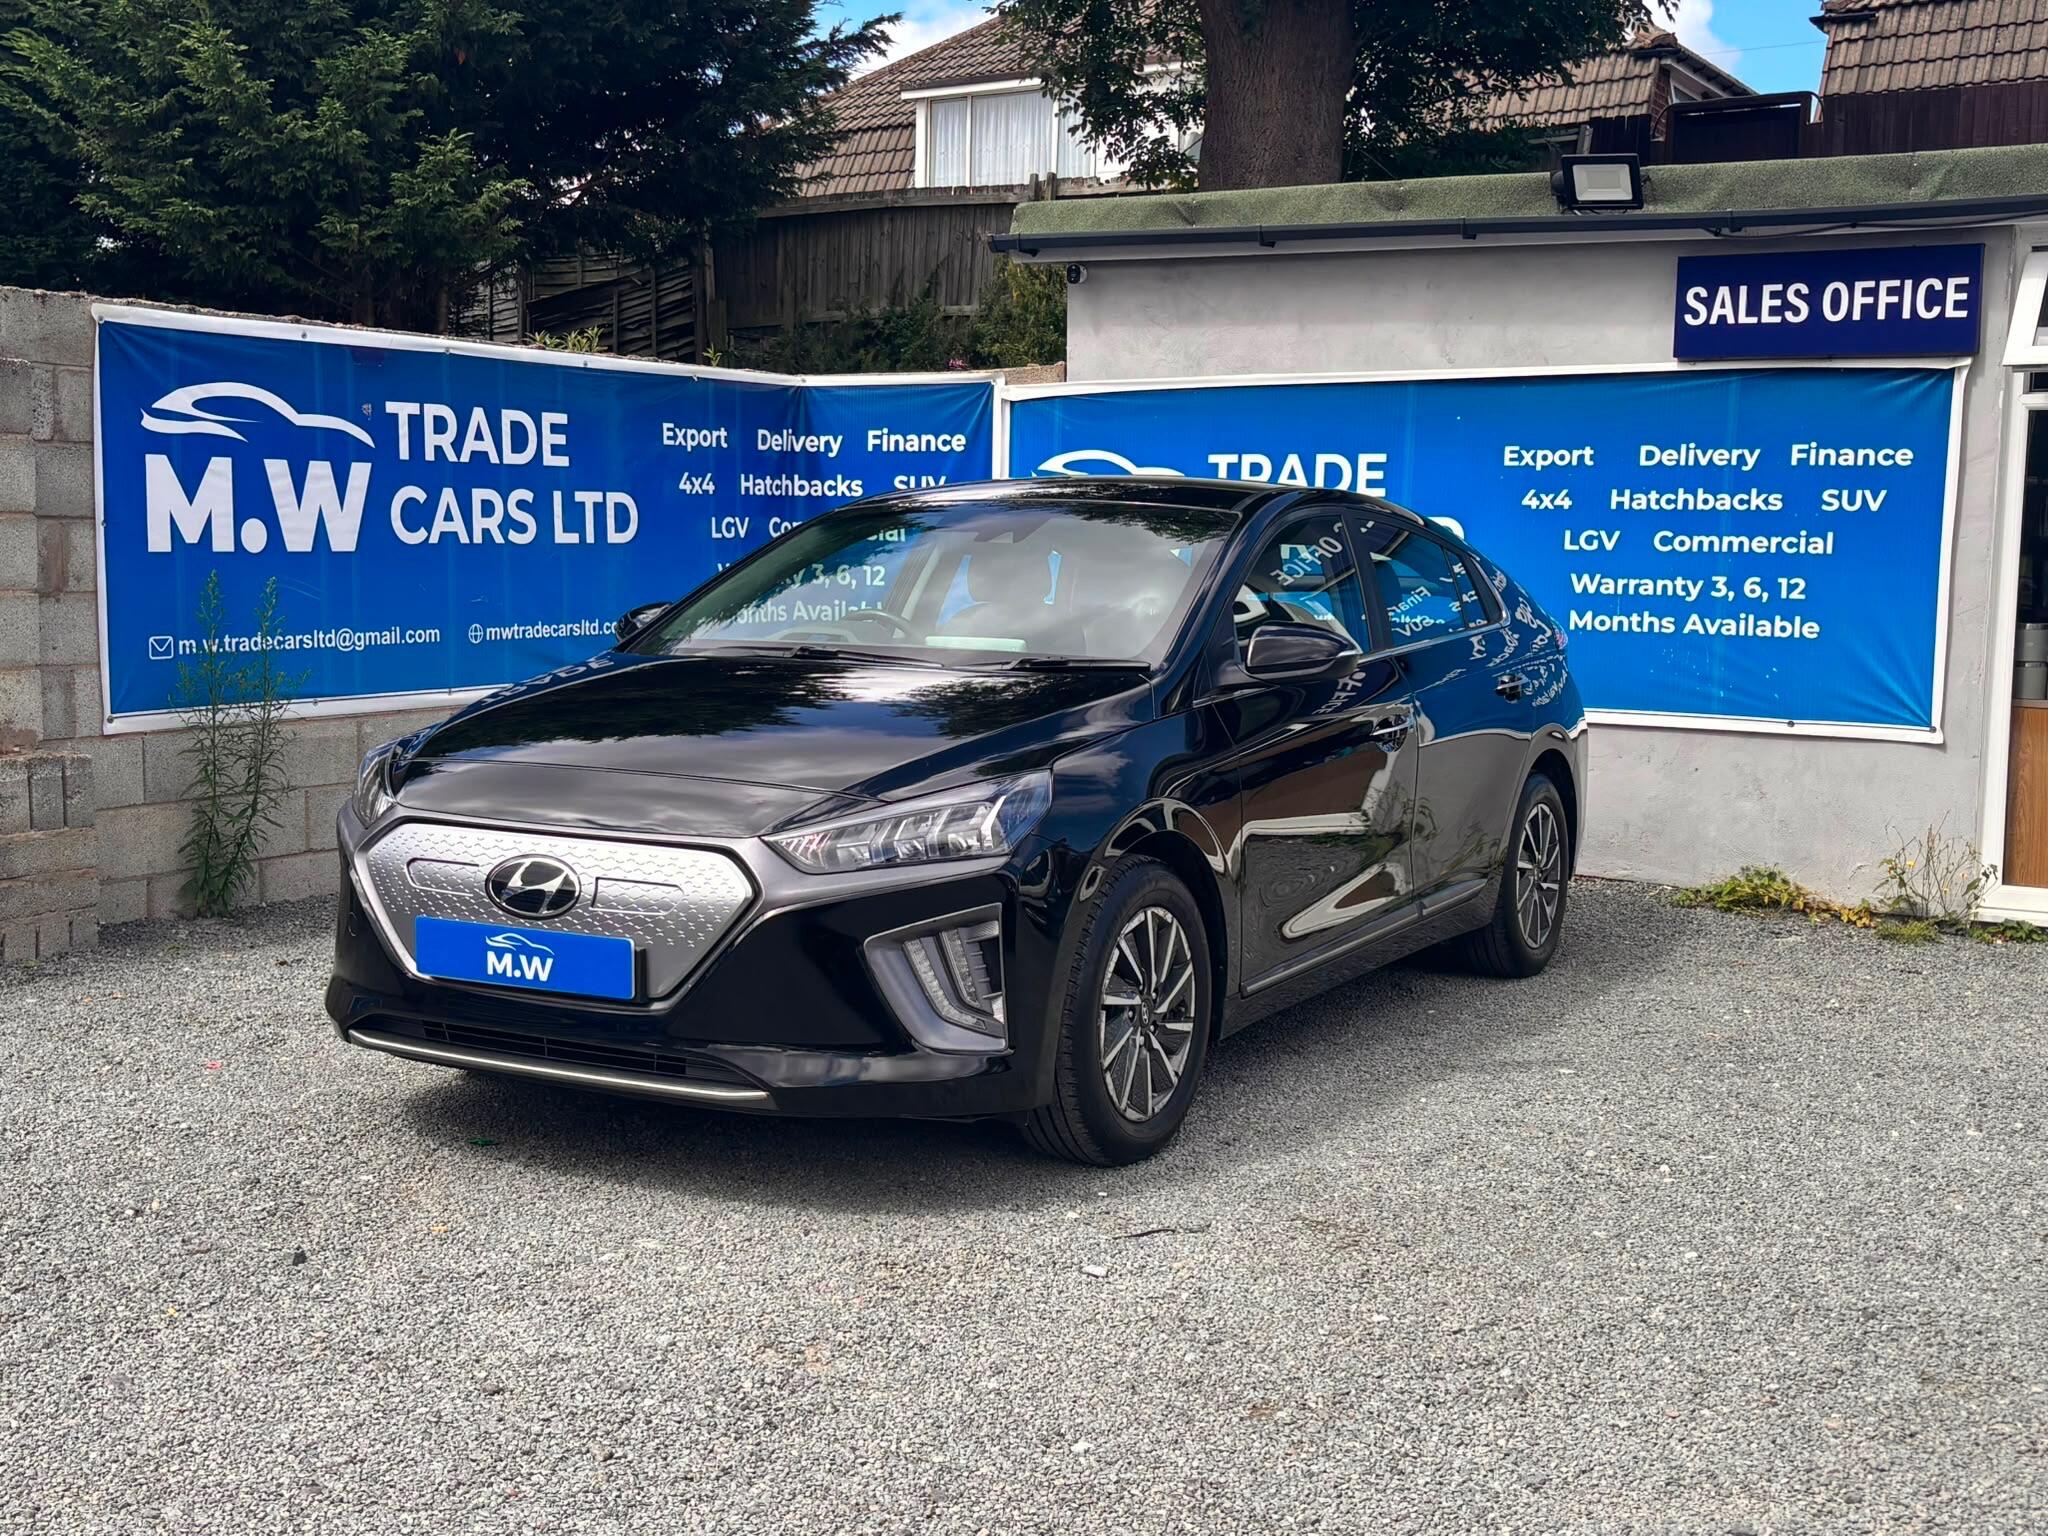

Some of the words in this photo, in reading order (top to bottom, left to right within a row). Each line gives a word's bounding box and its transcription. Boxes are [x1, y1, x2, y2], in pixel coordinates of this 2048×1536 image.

[1683, 282, 1810, 326] SALES
[1822, 276, 1970, 322] OFFICE
[385, 401, 570, 467] TRADE
[662, 423, 728, 451] Export
[757, 429, 843, 457] Delivery
[867, 428, 967, 452] Finance
[1503, 445, 1595, 471] Export
[1639, 443, 1761, 471] Delivery
[1790, 441, 1914, 467] Finance
[679, 472, 715, 495] 4x4
[740, 474, 863, 498] Hatchbacks
[893, 475, 947, 489] SUV
[1207, 453, 1388, 498] TRADE
[144, 454, 372, 553] M.W
[1521, 489, 1573, 510] 4x4
[1610, 488, 1784, 511] Hatchbacks
[1821, 488, 1888, 512] SUV
[390, 486, 537, 546] CARS
[553, 490, 639, 545] LTD
[711, 516, 750, 539] LGV
[1563, 529, 1621, 551] LGV
[1653, 530, 1834, 555] Commercial
[836, 564, 857, 589] 6,
[863, 565, 886, 587] 12
[1570, 573, 1704, 602] Warranty
[1710, 575, 1736, 602] 3,
[1743, 576, 1769, 603] 6,
[1777, 577, 1807, 600] 12
[736, 601, 788, 625] onths
[1569, 609, 1676, 634] Months
[1682, 612, 1821, 639] Available
[178, 627, 441, 655] m.w.tradecarsltd@gmail.com
[486, 619, 617, 641] mwtradecarsltd.co
[486, 950, 554, 982] M.W
